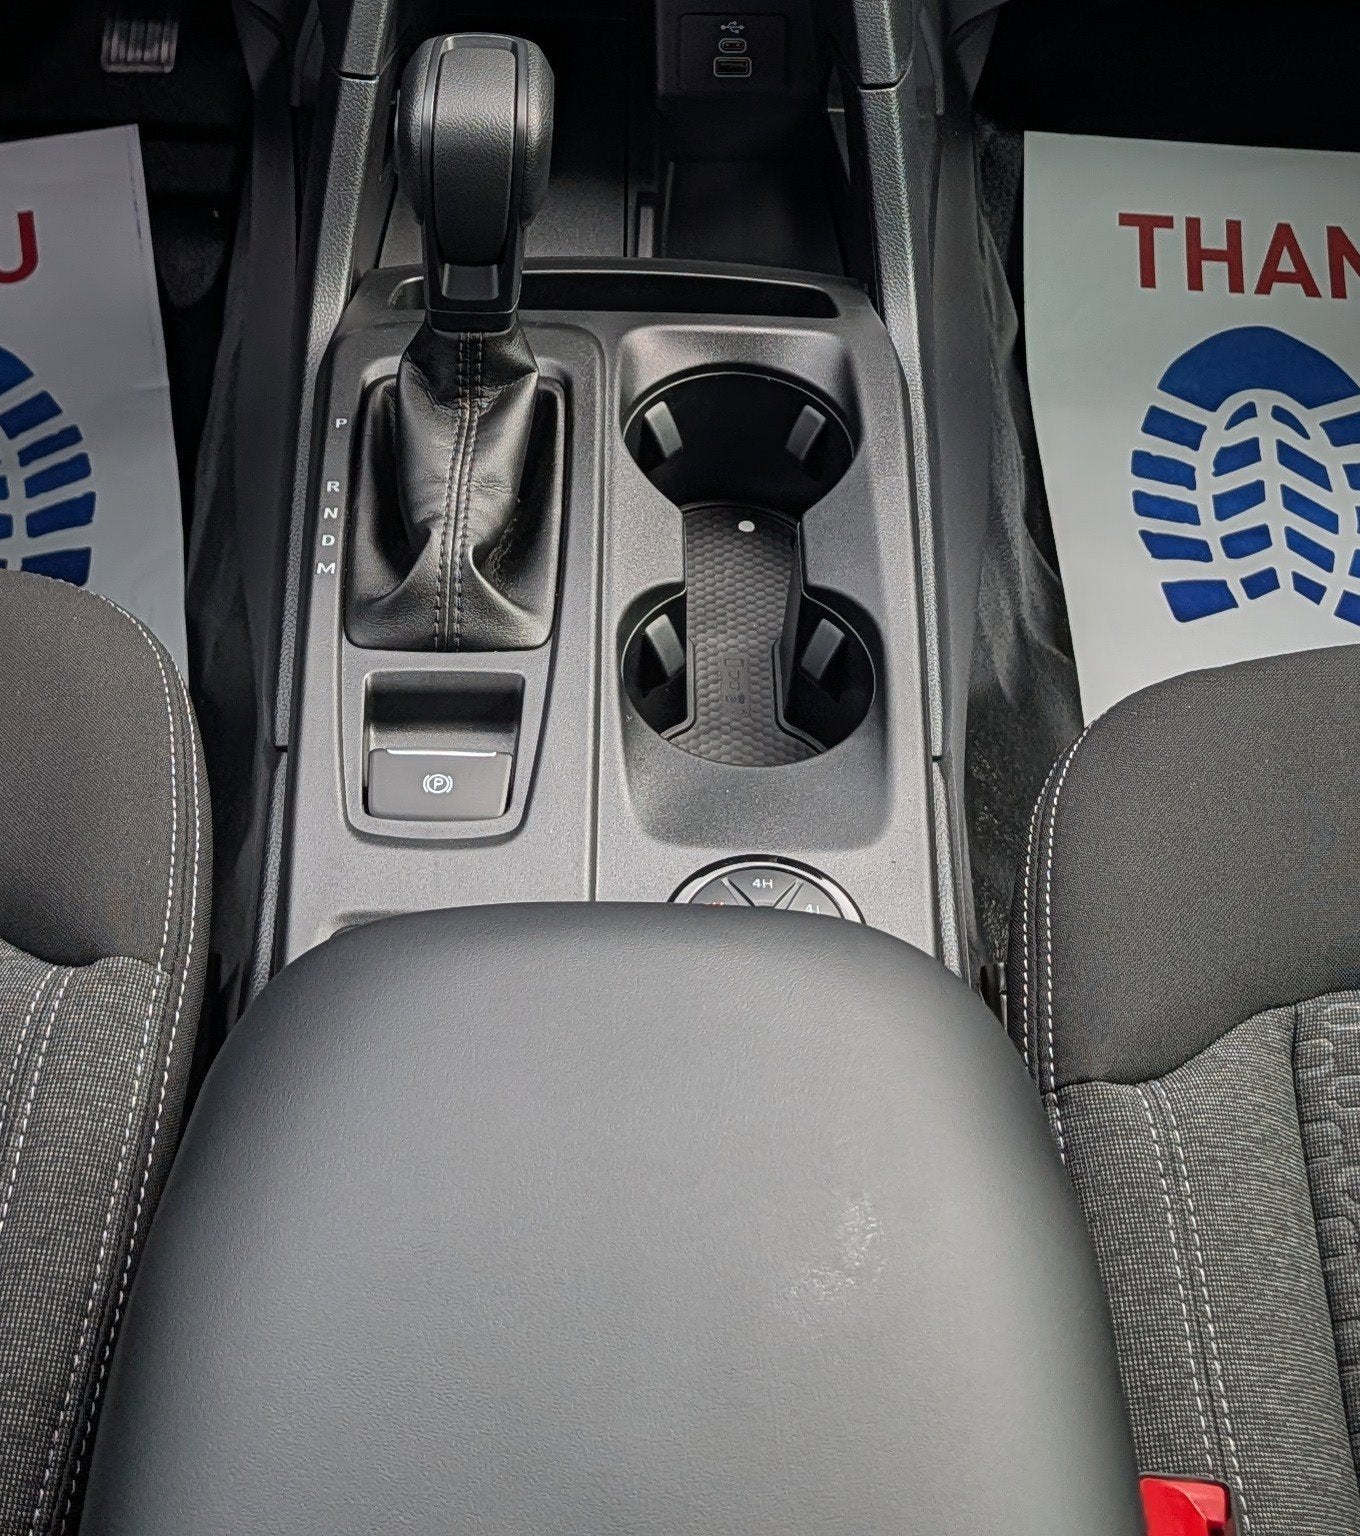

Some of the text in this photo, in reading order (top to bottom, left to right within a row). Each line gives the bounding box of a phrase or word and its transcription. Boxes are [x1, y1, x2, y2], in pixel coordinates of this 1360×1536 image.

[335, 418, 348, 429] P
[326, 480, 341, 493] R
[323, 507, 339, 520] N
[321, 534, 336, 547] D
[316, 562, 336, 575] M
[752, 878, 774, 889] 4H
